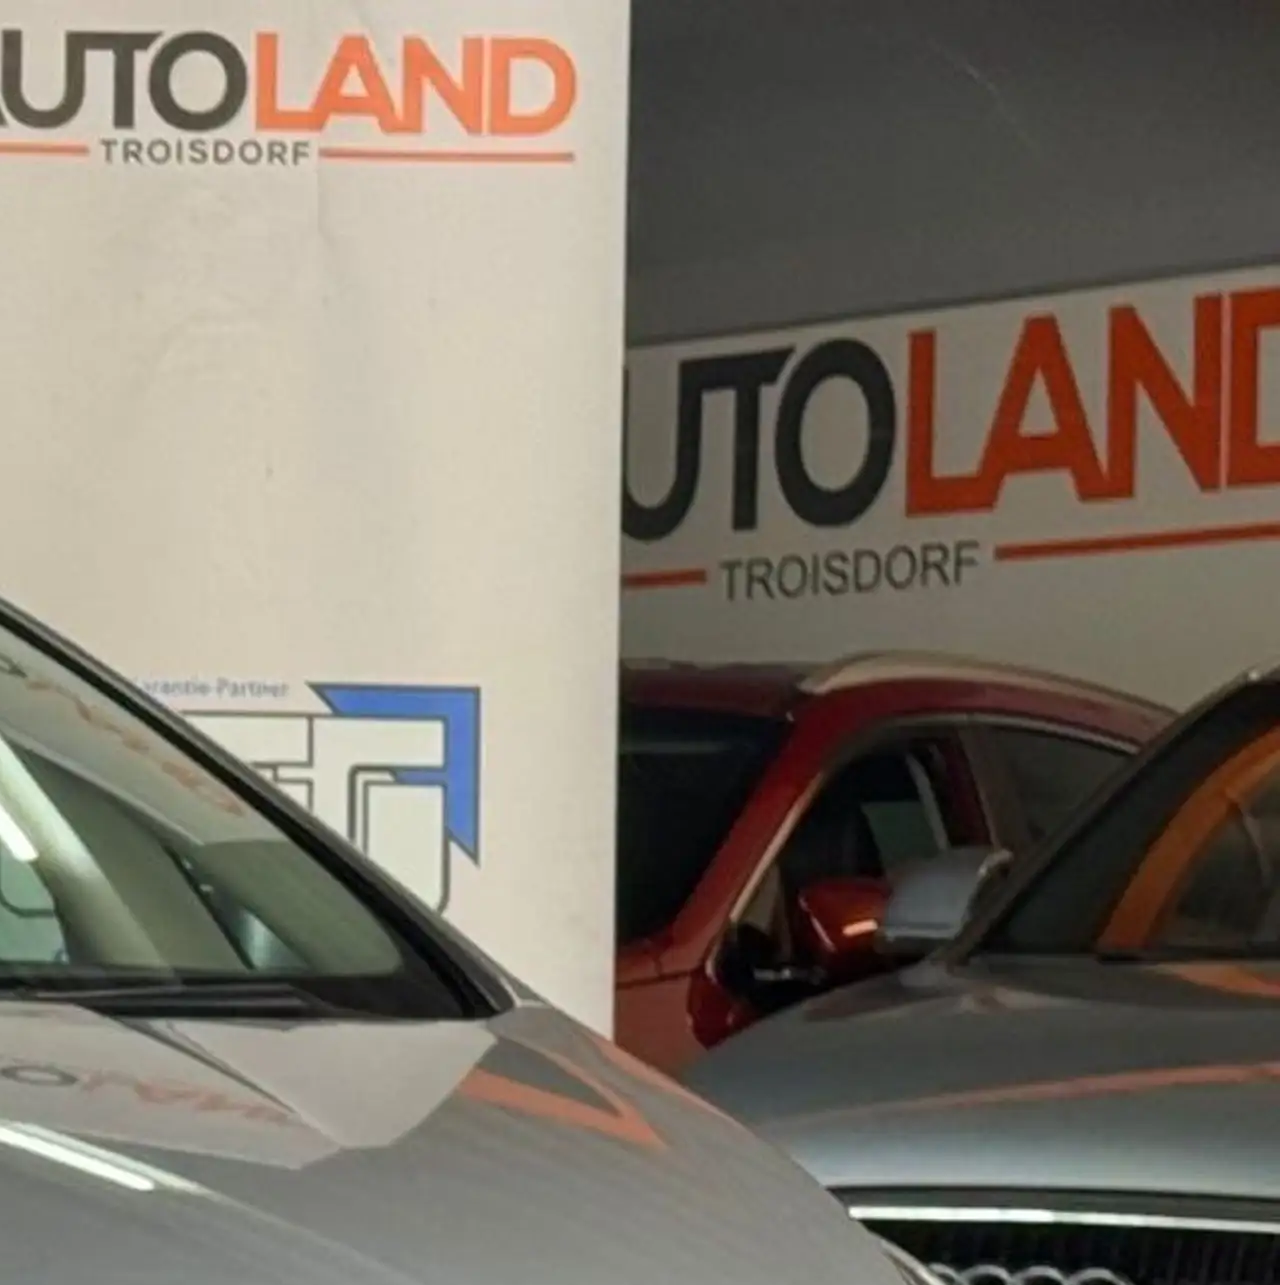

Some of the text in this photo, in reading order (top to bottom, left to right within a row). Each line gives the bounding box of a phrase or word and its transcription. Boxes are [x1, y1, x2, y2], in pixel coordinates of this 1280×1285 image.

[100, 138, 310, 167] TROISDORF
[622, 285, 1280, 543] UTOLAN
[721, 541, 980, 600] TROISDORF
